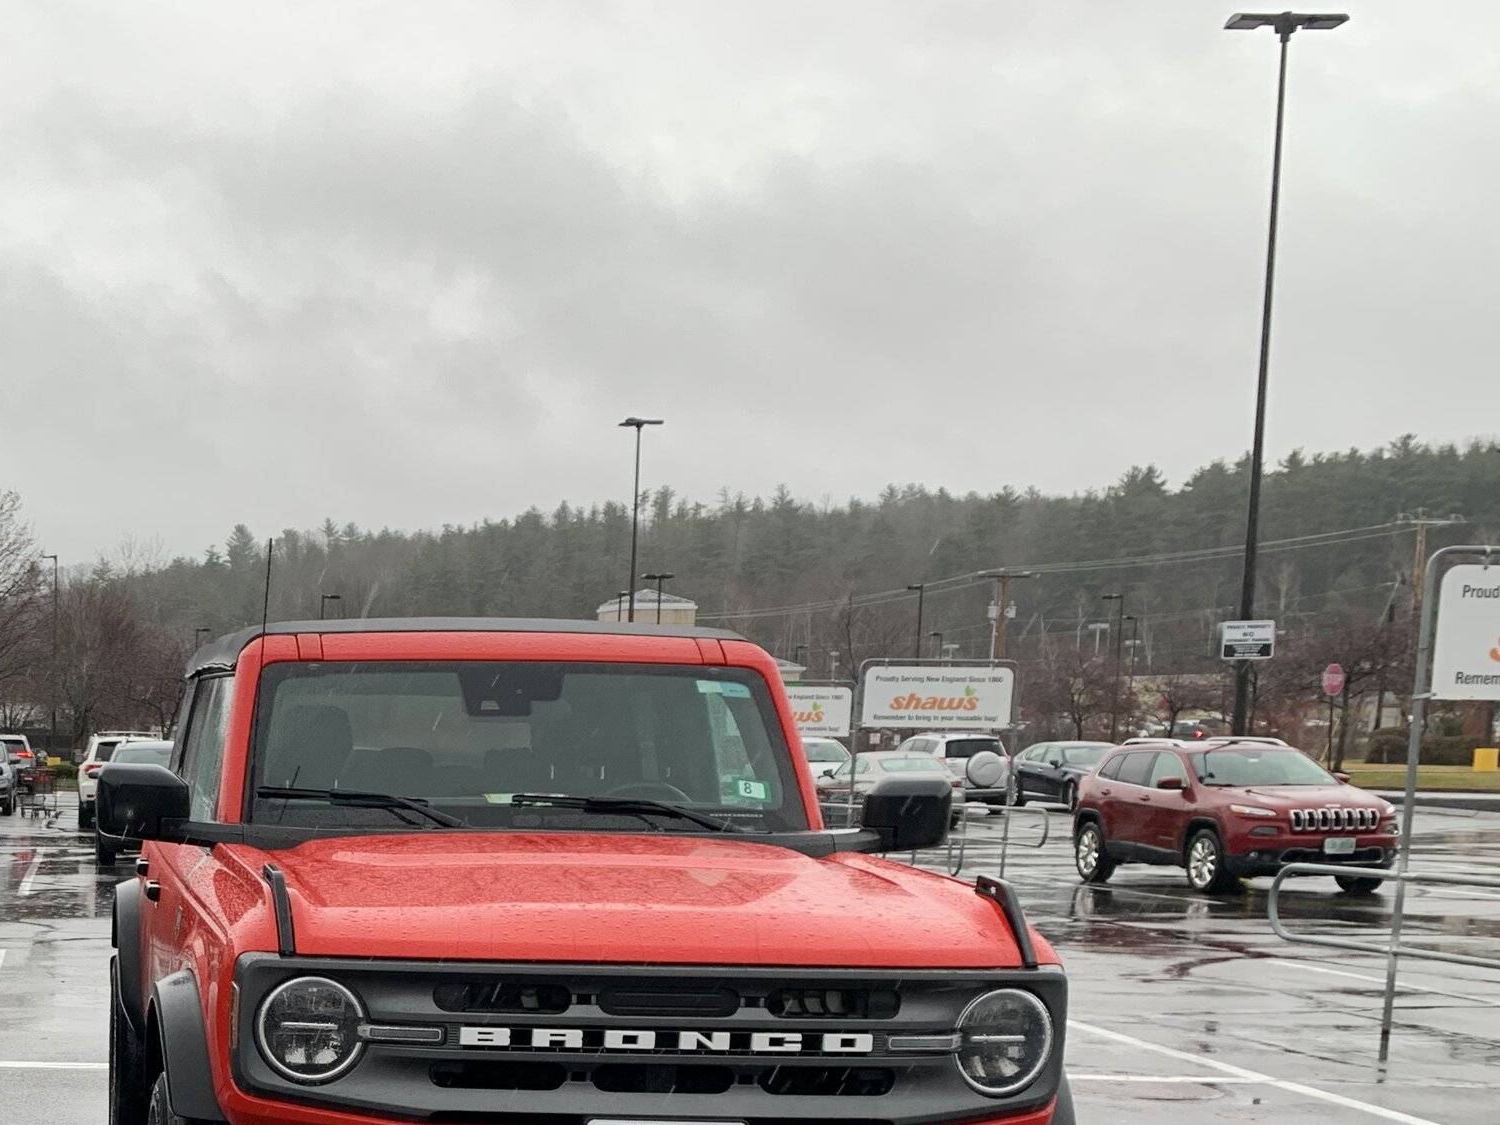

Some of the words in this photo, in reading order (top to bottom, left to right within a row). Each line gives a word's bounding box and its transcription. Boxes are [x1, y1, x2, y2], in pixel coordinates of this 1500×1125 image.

[876, 675, 900, 683] Proudly
[901, 675, 925, 684] Serving
[941, 676, 968, 684] England
[744, 782, 752, 794] 8
[460, 1026, 874, 1053] BRONCO
